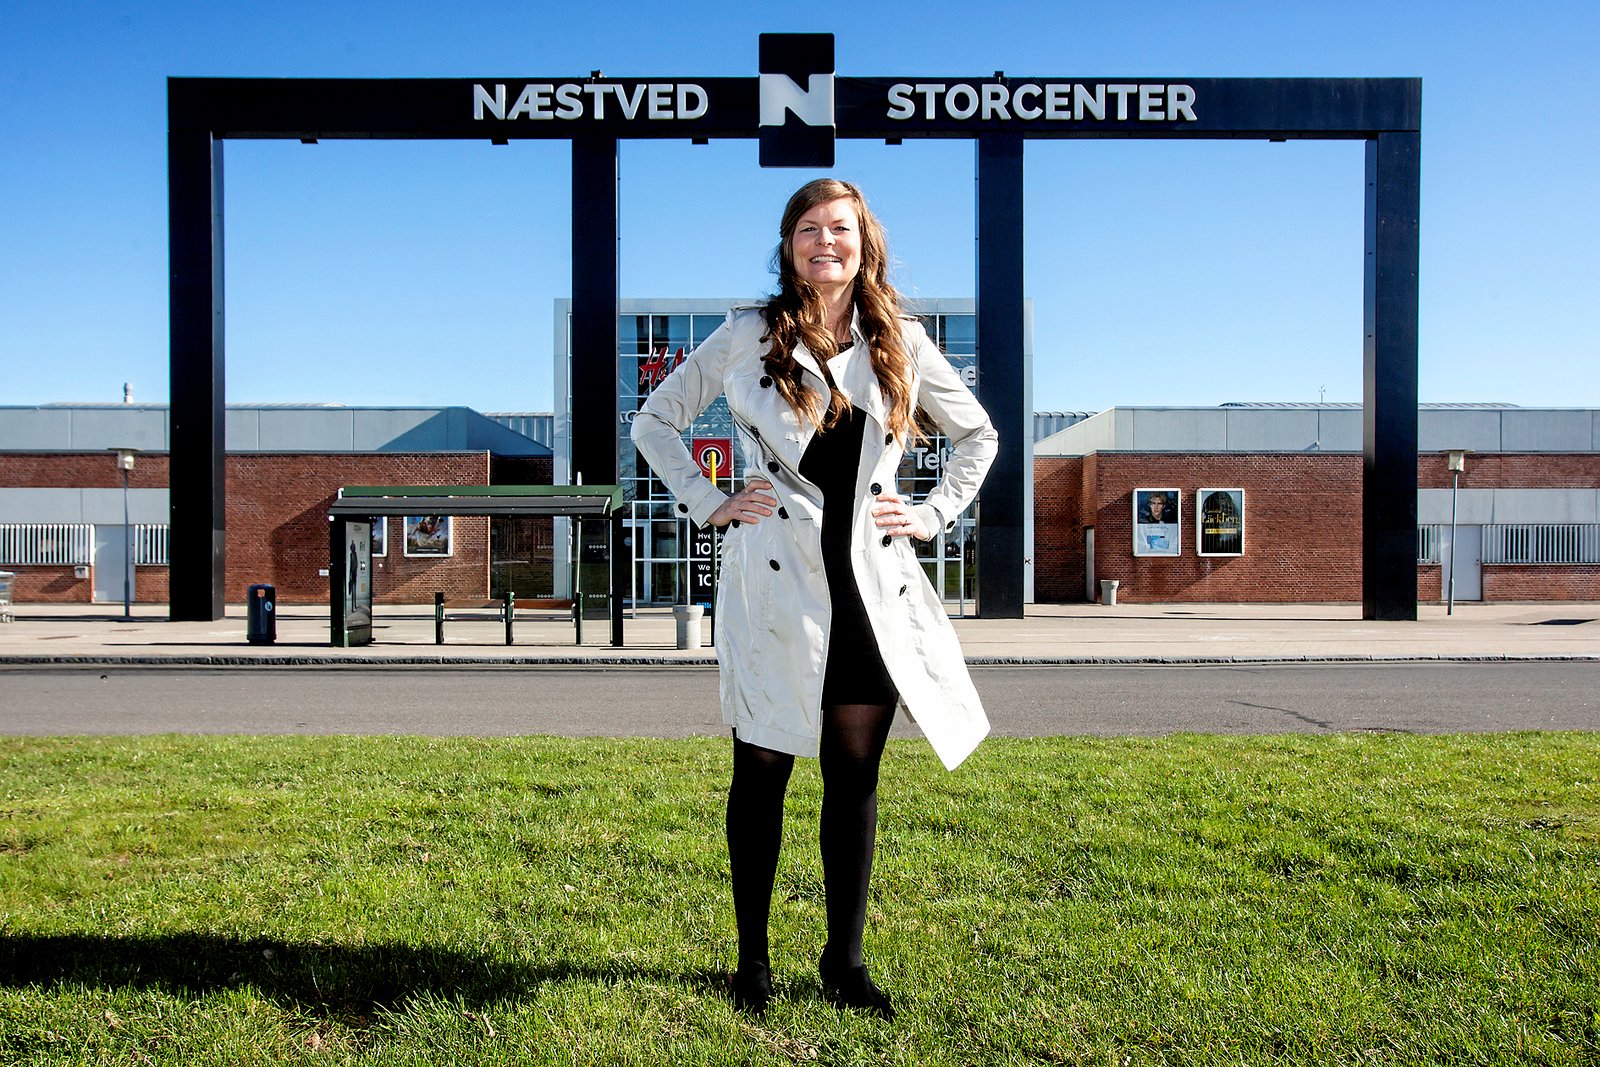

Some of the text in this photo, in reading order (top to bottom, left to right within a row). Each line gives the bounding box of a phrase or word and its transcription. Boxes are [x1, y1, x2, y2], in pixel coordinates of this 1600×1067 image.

[473, 73, 1197, 126] NÆSTVED N STORCENTER
